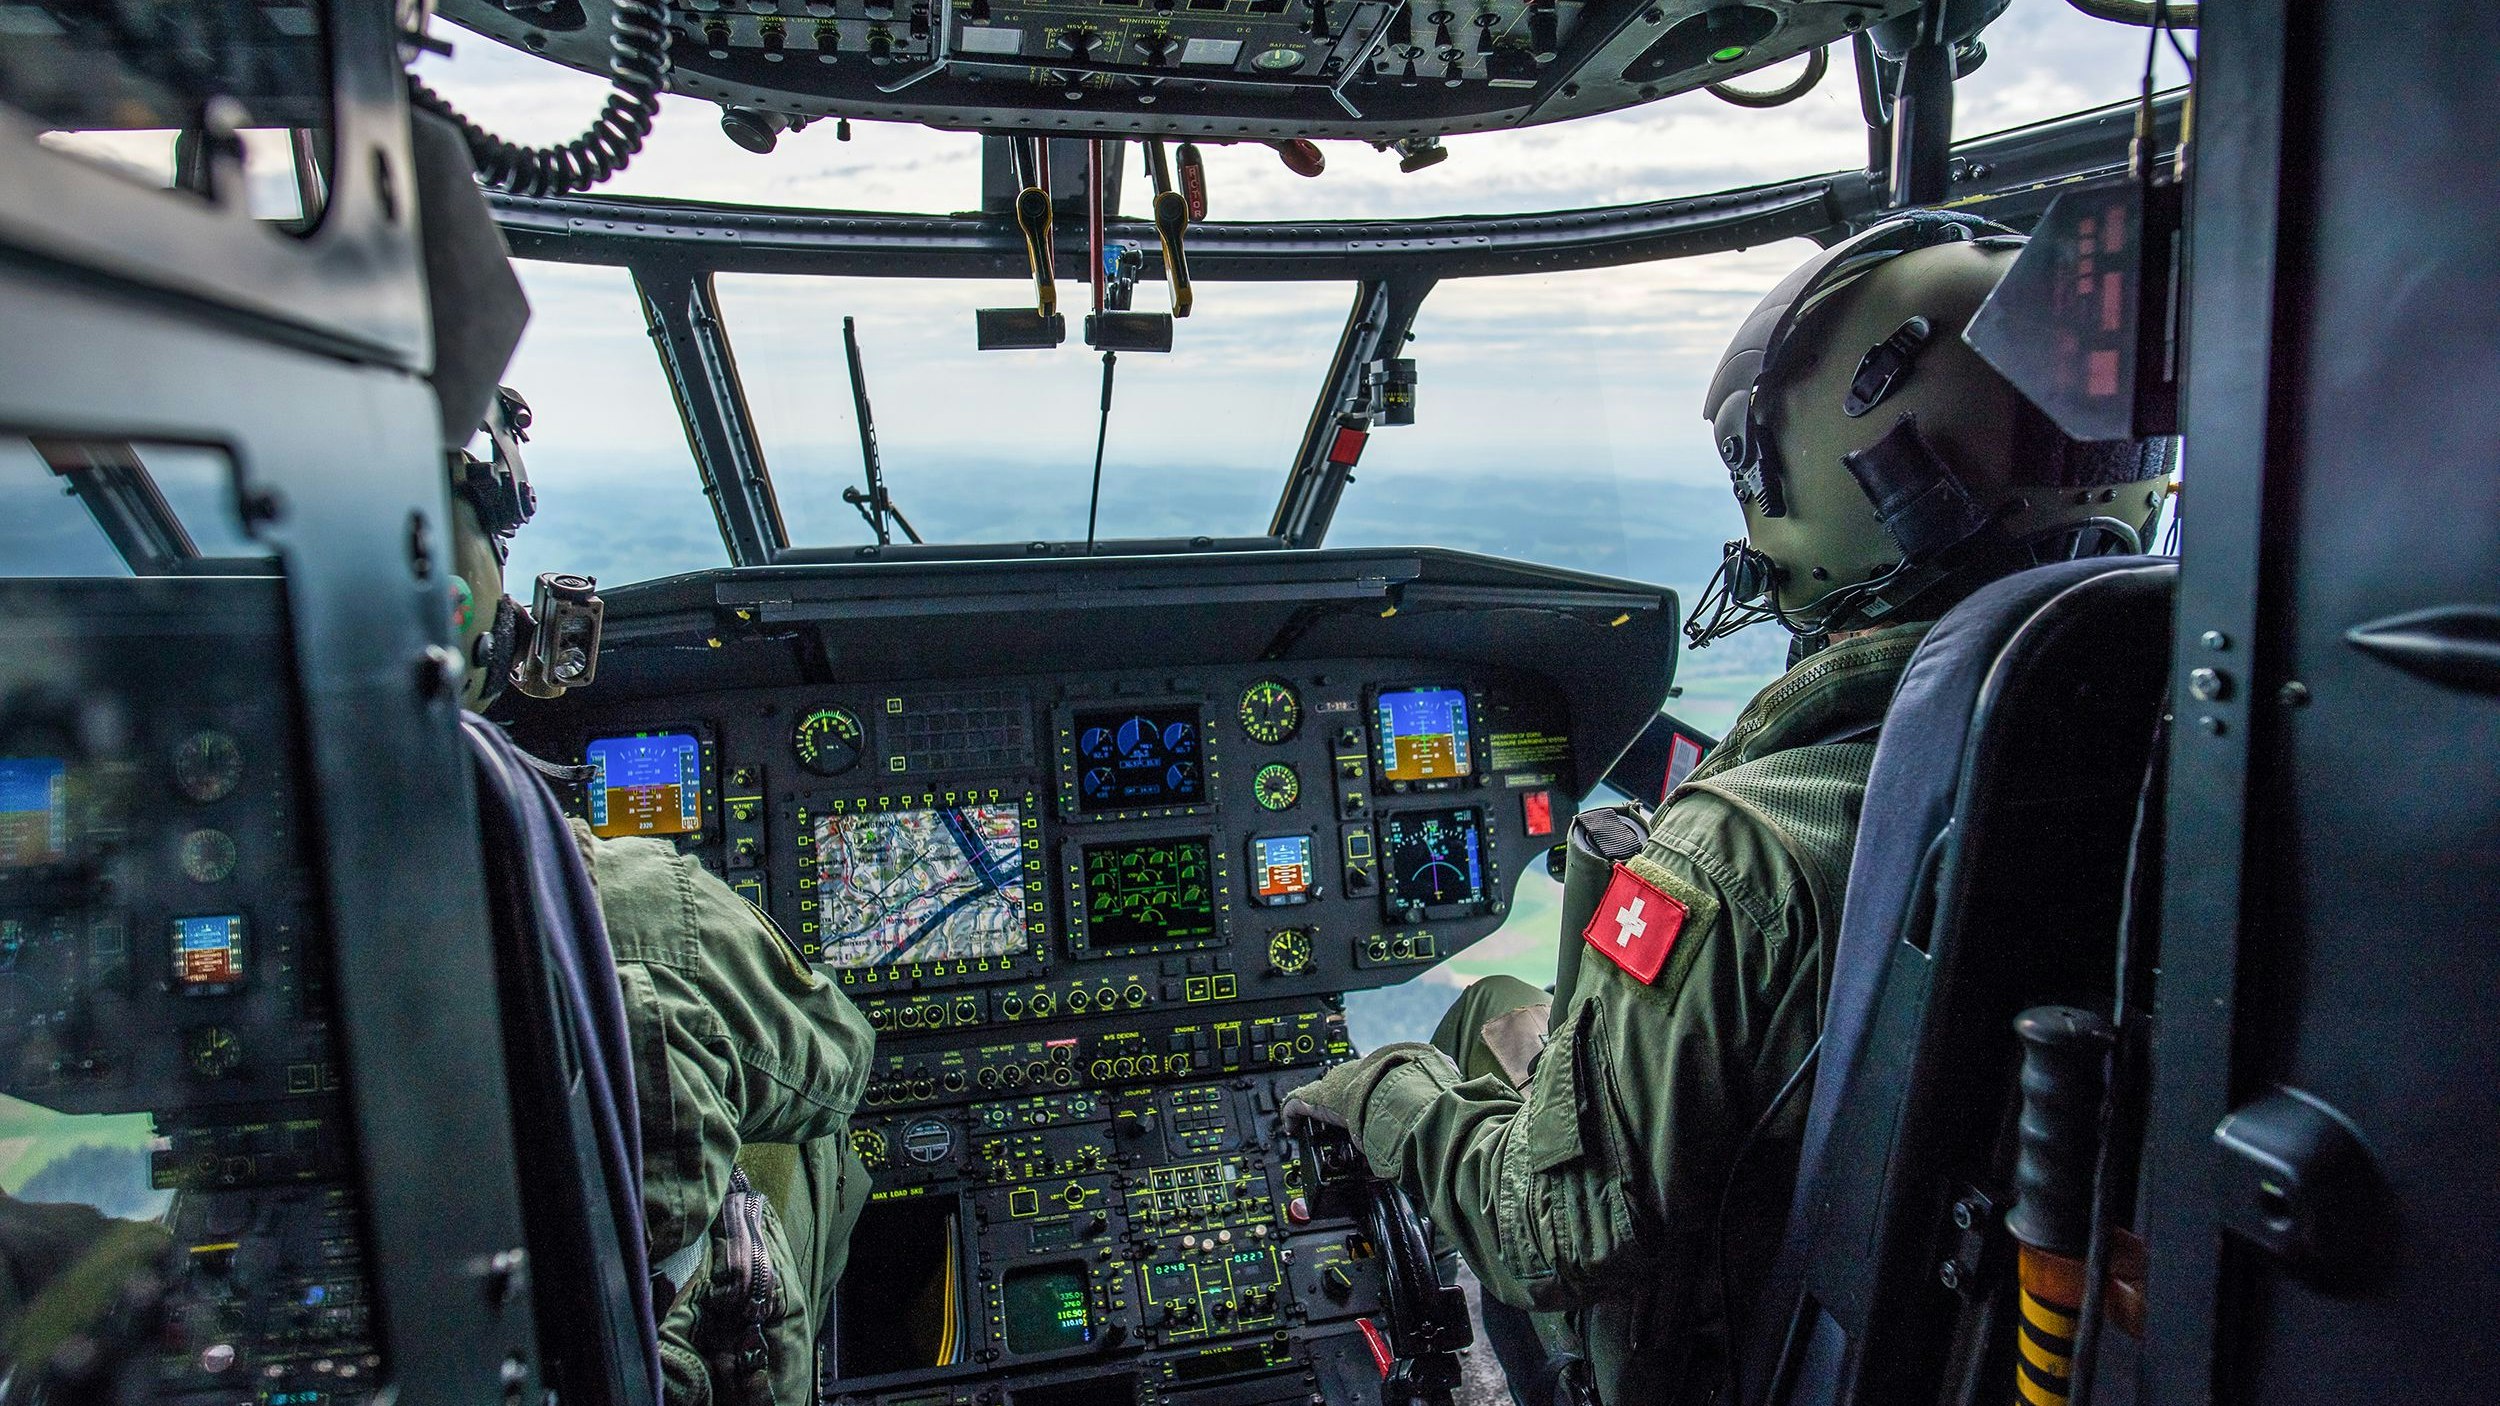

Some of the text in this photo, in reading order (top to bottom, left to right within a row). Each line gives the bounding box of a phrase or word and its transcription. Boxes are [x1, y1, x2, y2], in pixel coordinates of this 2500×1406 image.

[1119, 17, 1170, 26] MONITORING
[1189, 168, 1202, 217] ROTOR
[1116, 1031, 1139, 1039] DEICING
[872, 1192, 888, 1200] MAX
[890, 1189, 908, 1198] LOAD
[1234, 1252, 1264, 1263] 0227
[1155, 1263, 1185, 1275] 0248
